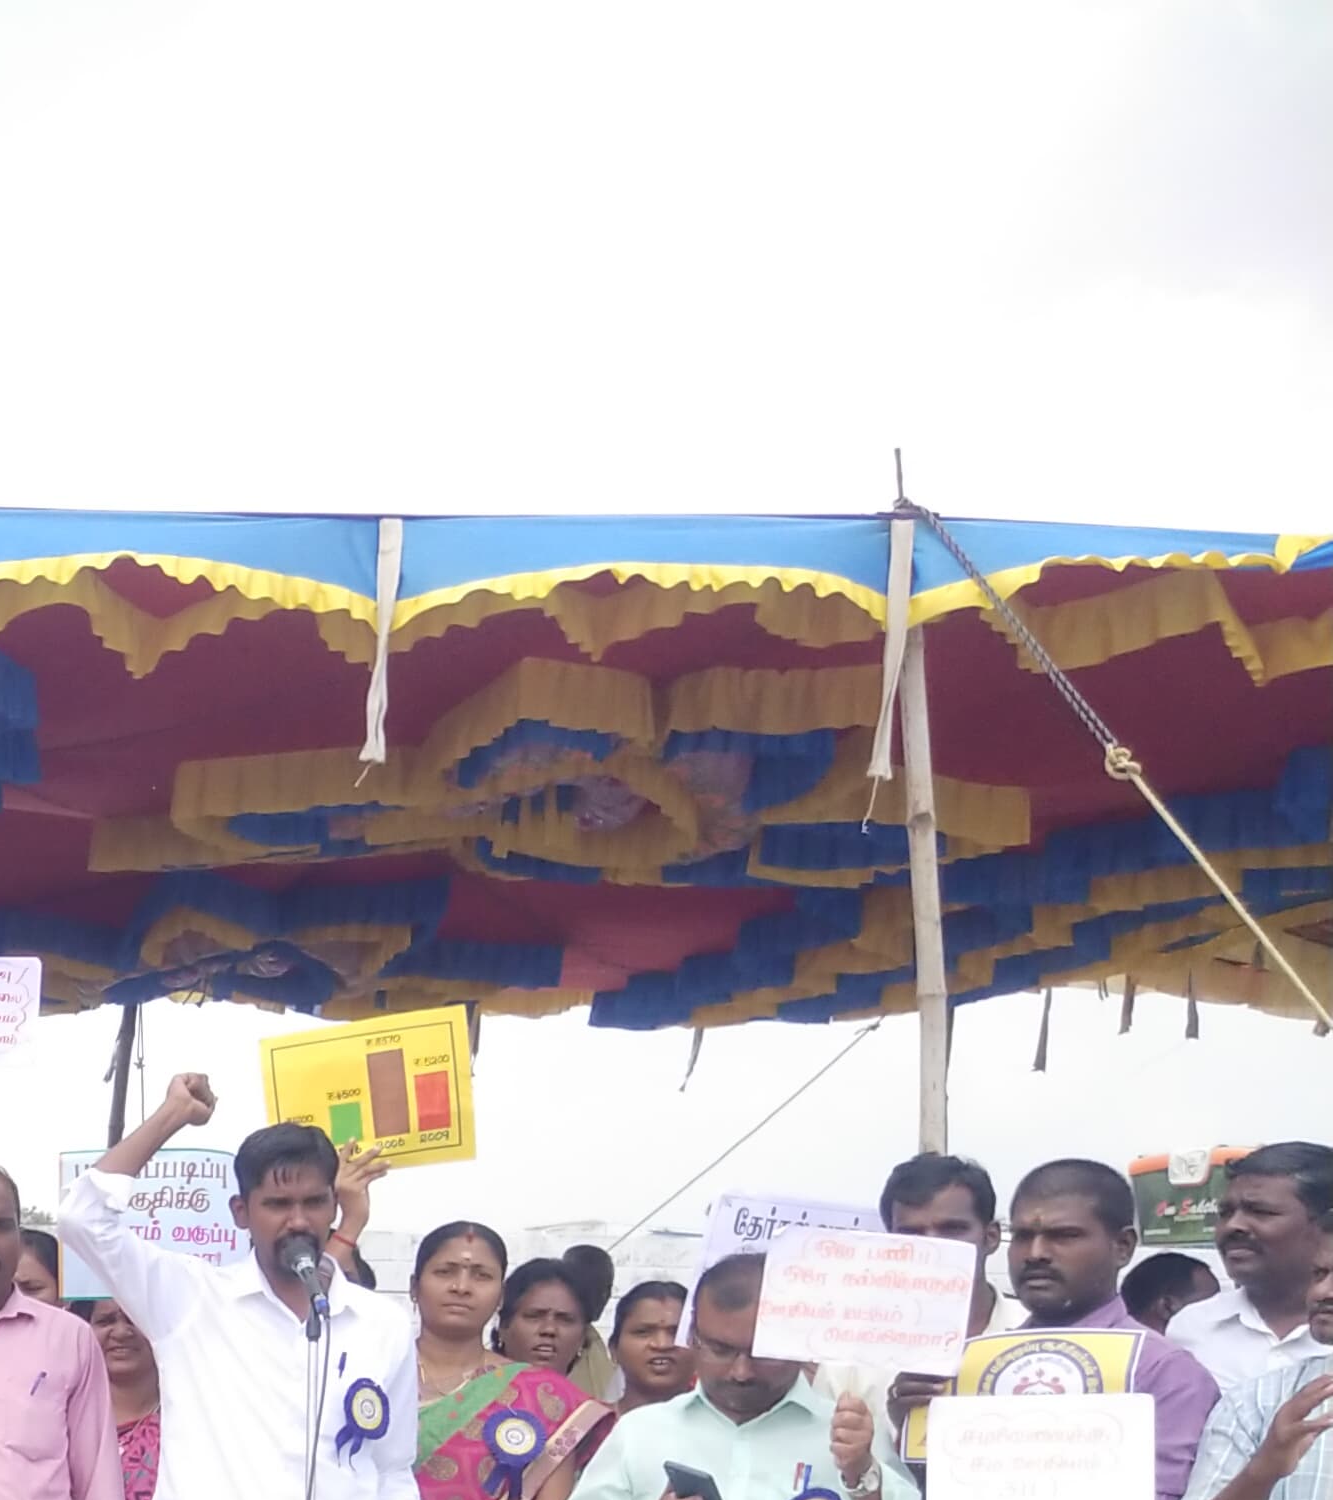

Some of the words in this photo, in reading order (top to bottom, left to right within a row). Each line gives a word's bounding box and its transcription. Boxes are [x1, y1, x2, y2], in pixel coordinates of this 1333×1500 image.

[420, 1130, 450, 1143] 2009
[128, 1186, 211, 1219] குதிக்கு
[172, 1223, 237, 1251] வகுப்பு
[733, 1206, 810, 1242] தேர்
